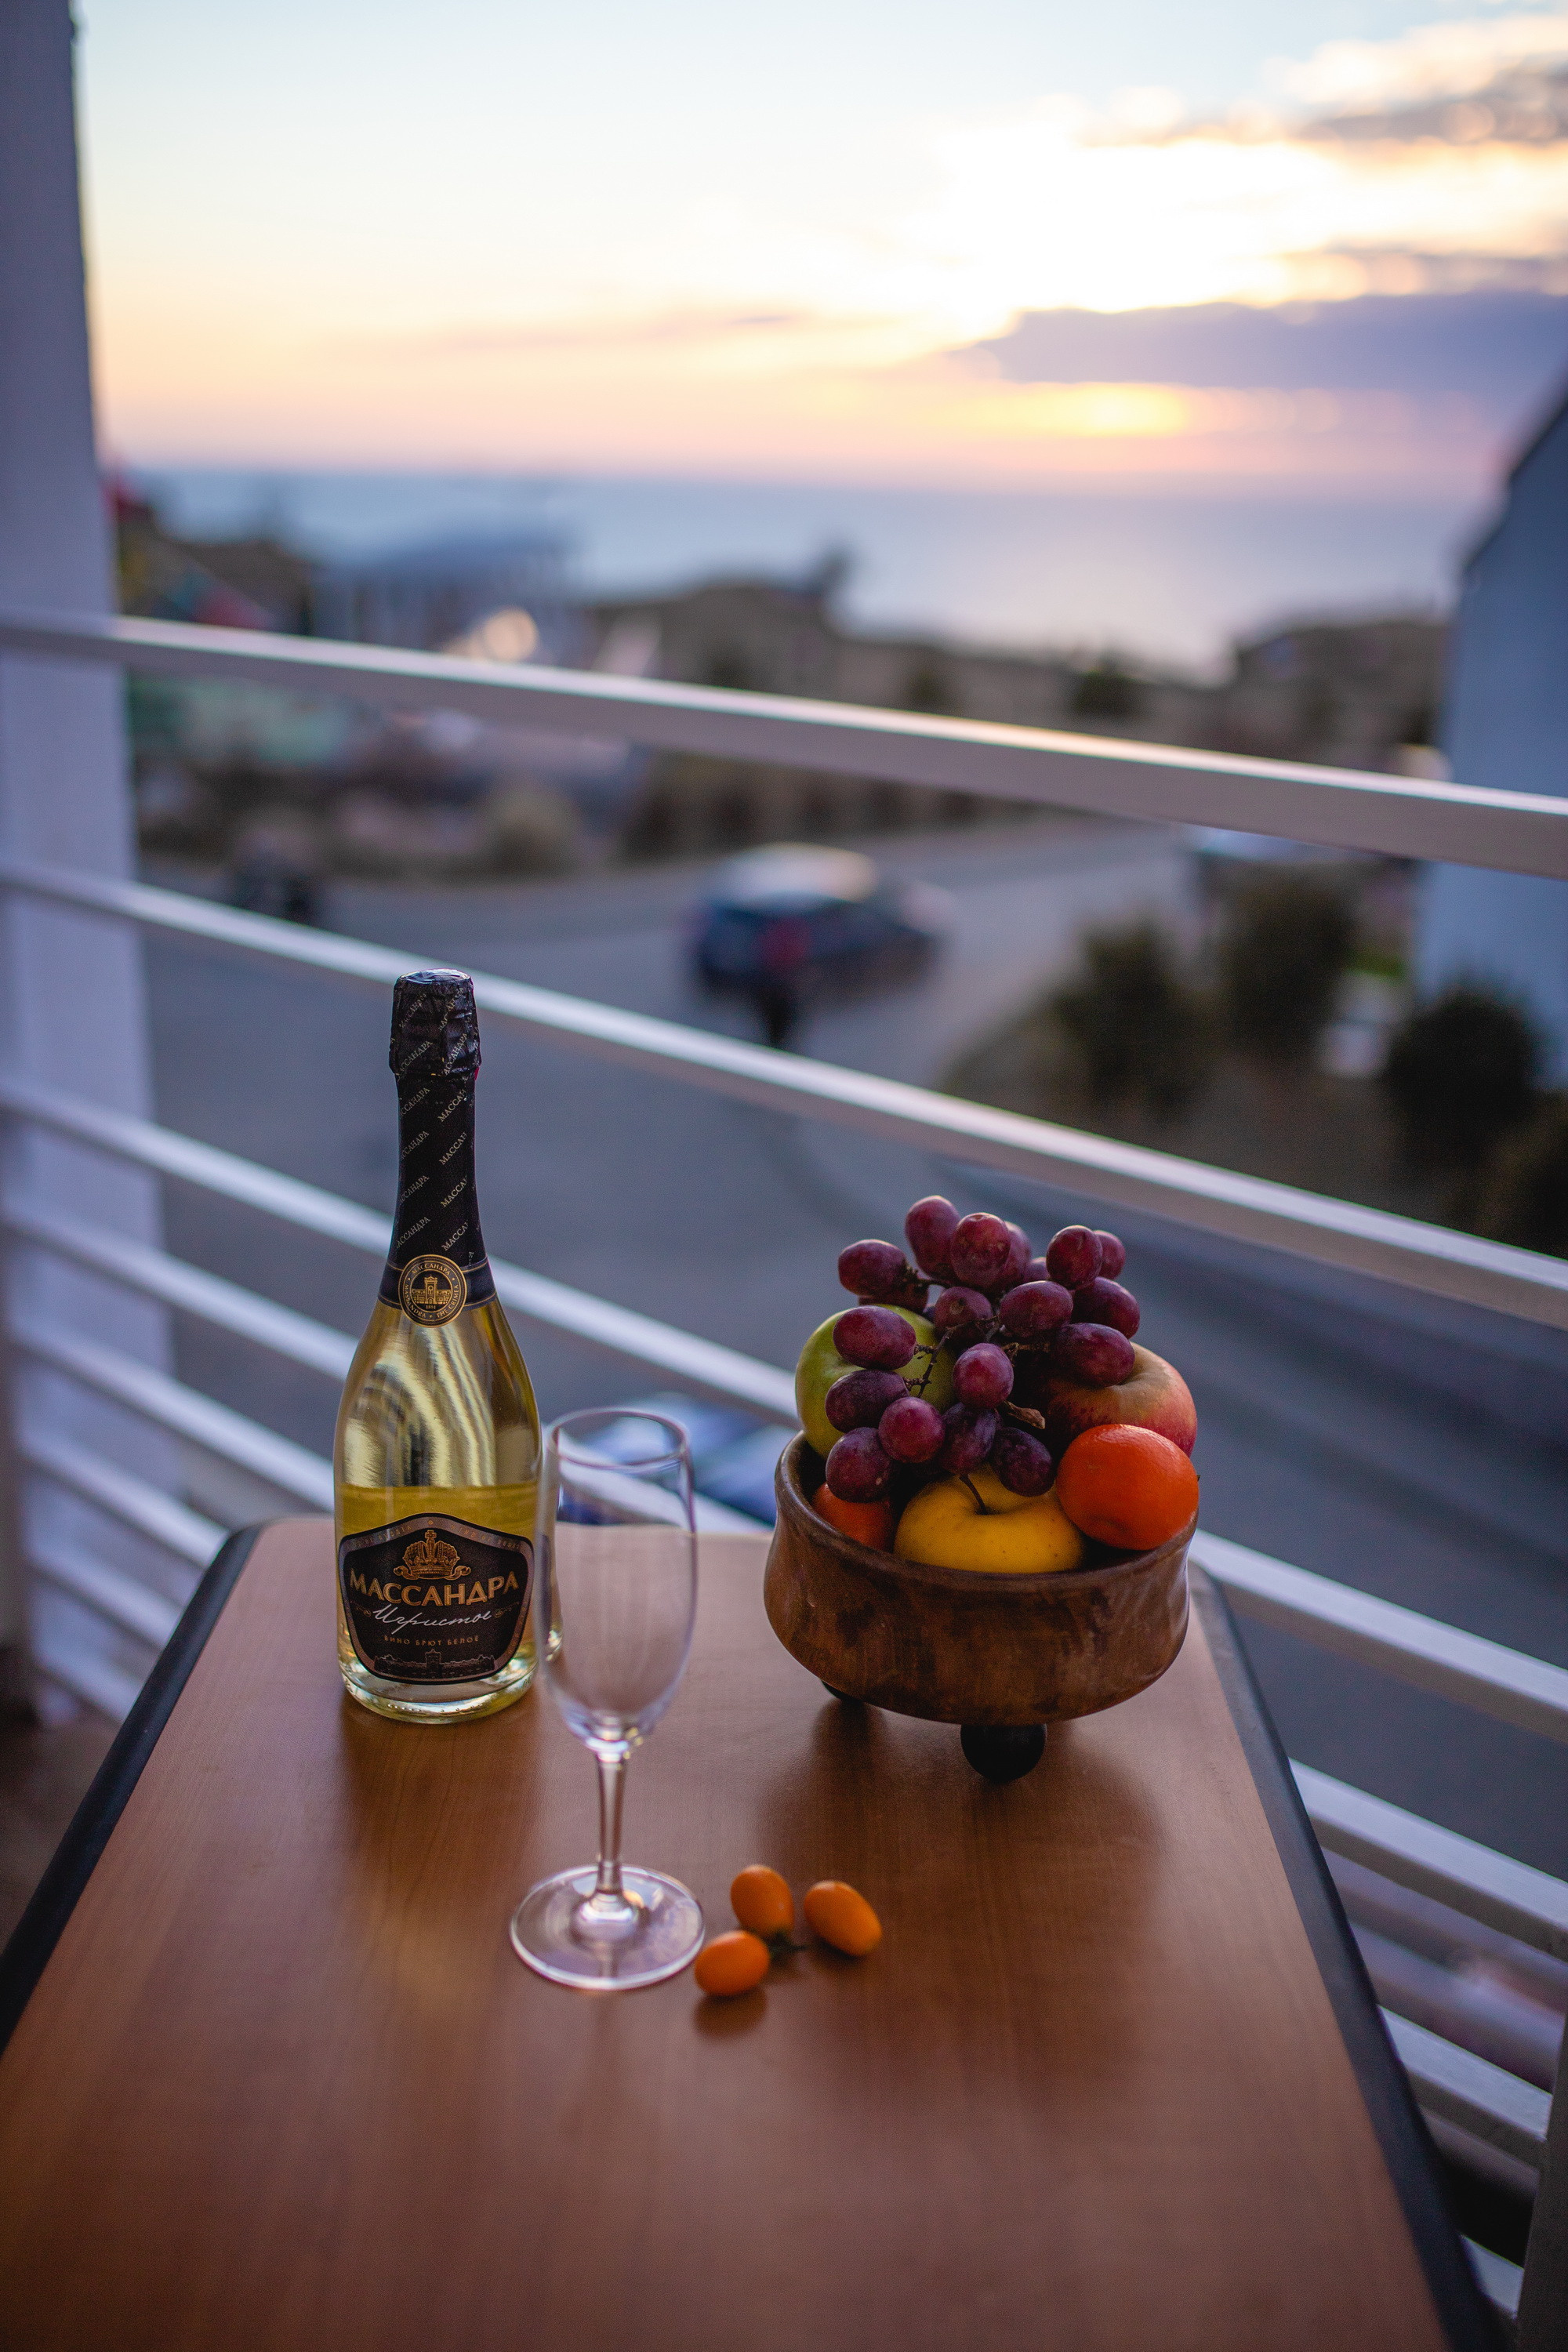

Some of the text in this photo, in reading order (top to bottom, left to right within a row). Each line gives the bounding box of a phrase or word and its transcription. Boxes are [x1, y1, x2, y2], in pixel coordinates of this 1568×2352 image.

[350, 1567, 519, 1606] МАССАНДРА
[372, 1603, 492, 1635] Игристое
[383, 1634, 410, 1644] ВИНО
[447, 1635, 479, 1646] БЕЛОЕ
